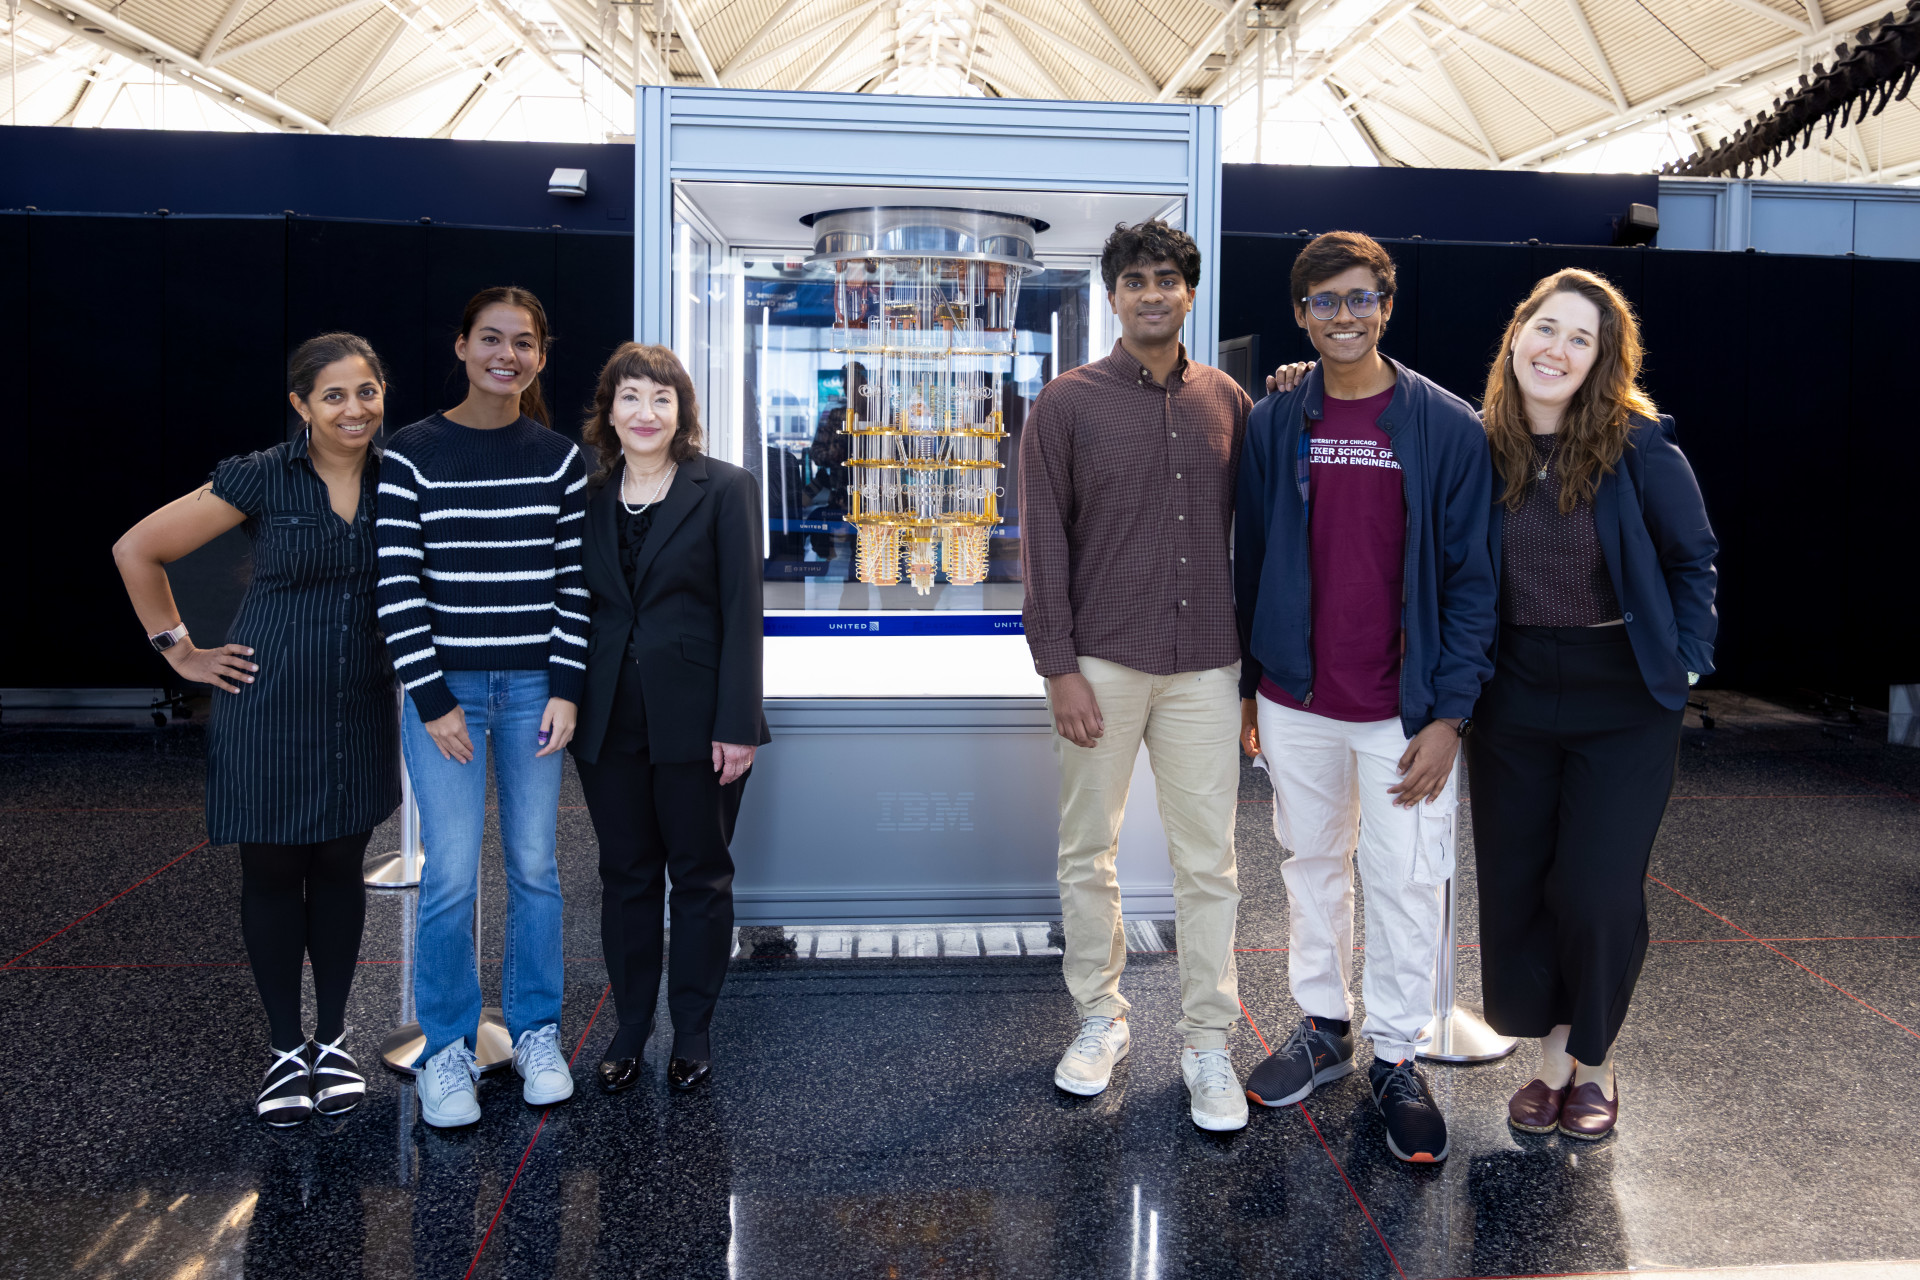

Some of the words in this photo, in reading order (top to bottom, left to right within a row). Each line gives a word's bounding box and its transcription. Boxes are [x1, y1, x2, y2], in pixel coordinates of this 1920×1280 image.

[1337, 447, 1377, 458] SCHOOL
[1379, 450, 1393, 459] OF
[877, 792, 974, 831] IBM
